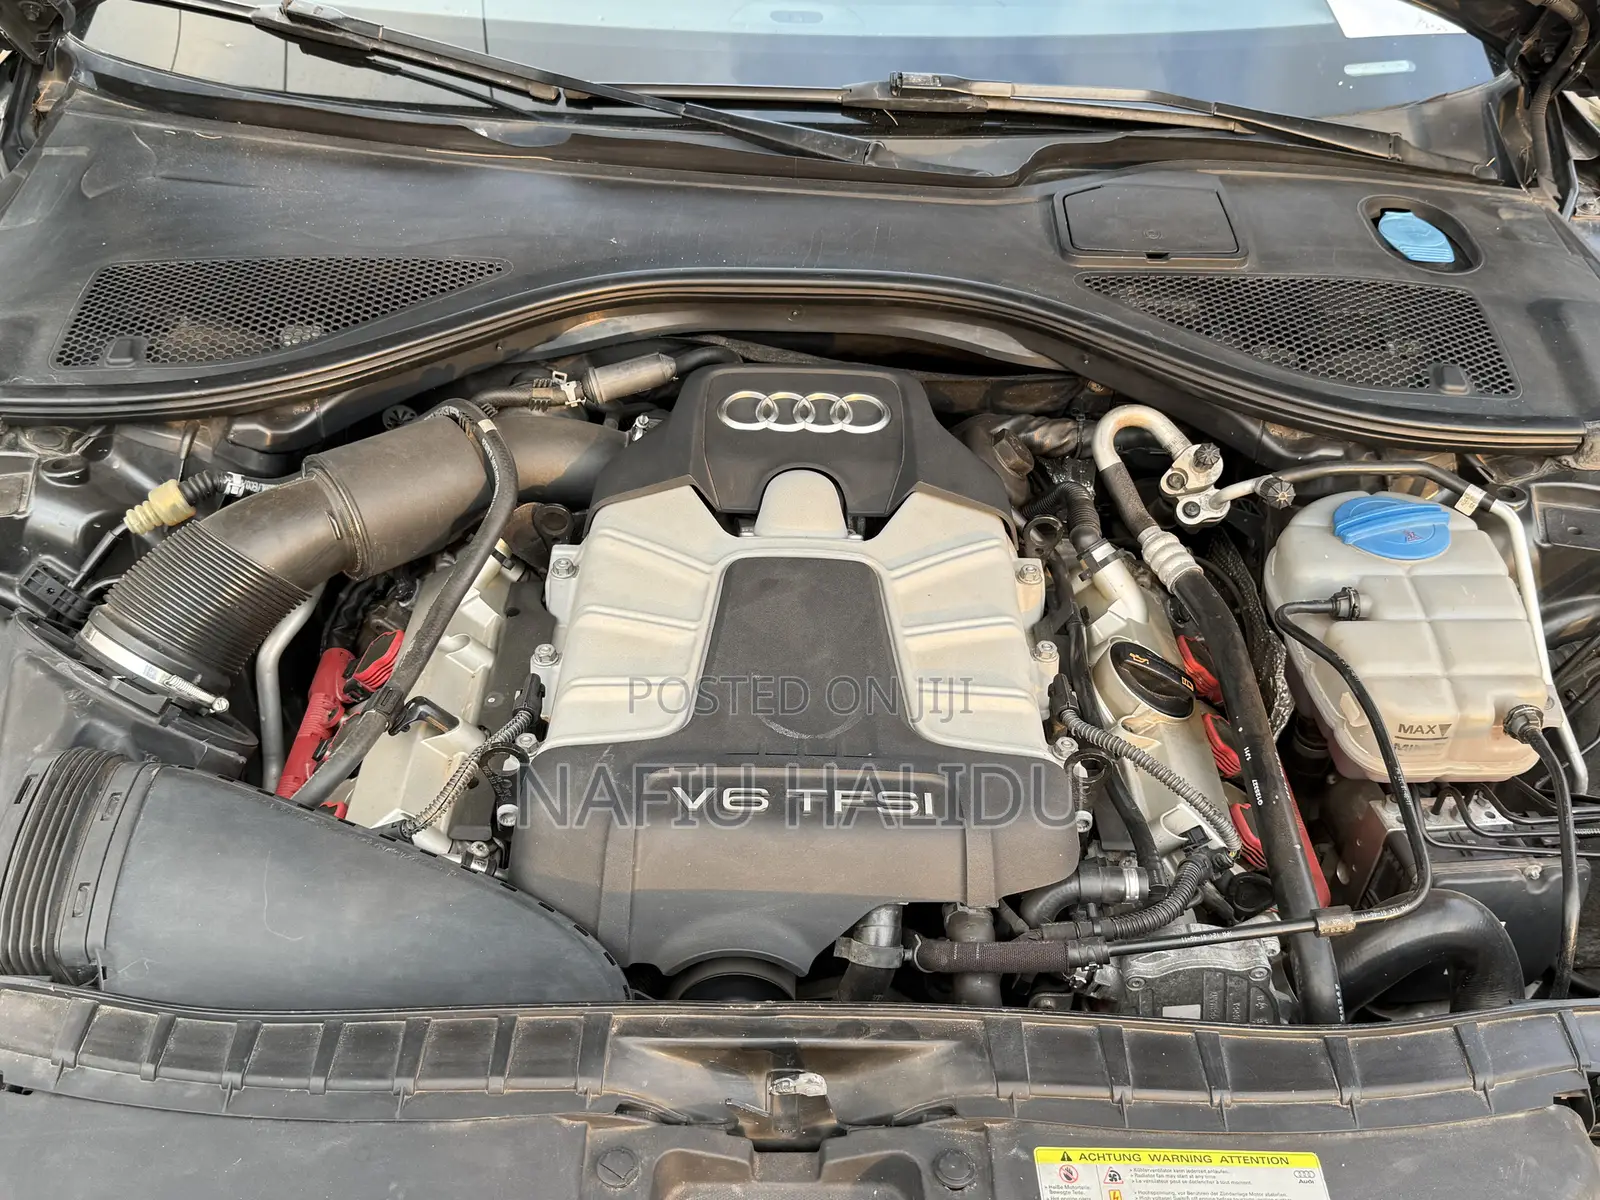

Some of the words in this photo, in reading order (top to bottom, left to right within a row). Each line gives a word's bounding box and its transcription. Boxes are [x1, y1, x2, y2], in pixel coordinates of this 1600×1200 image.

[1398, 723, 1437, 734] MAX
[671, 786, 771, 814] V6
[785, 786, 934, 816] TFSI
[1079, 1153, 1141, 1161] ACHTUNG
[1148, 1154, 1212, 1163] WARNING
[1220, 1155, 1289, 1165] ATTENTION
